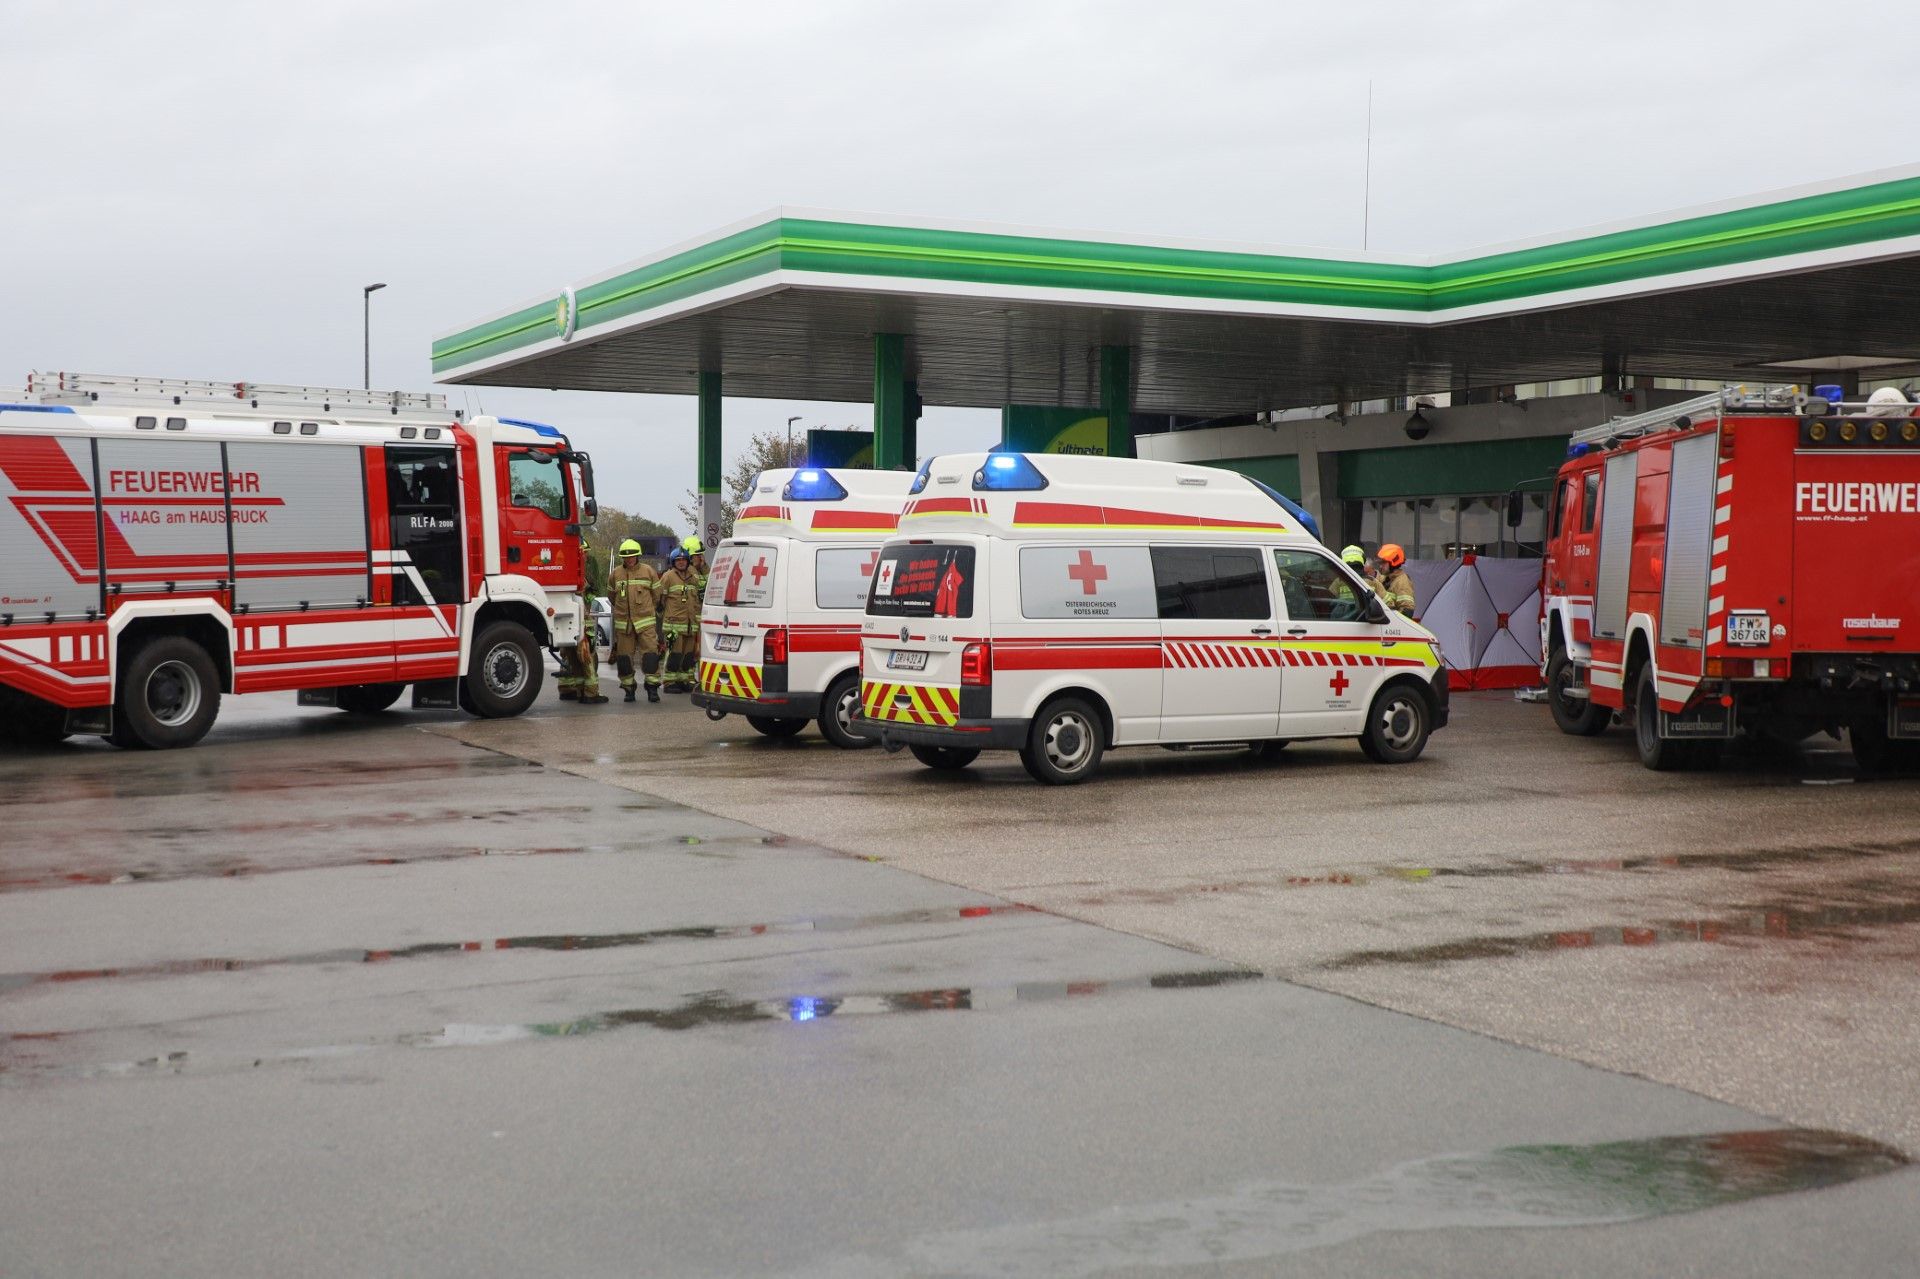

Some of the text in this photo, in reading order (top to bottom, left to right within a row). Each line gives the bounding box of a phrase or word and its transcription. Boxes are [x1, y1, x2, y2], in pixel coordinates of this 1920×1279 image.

[110, 470, 260, 493] FEUERWEHR
[1796, 482, 1920, 513] FEUERWE
[120, 510, 268, 524] HAAG am HAUSRUCK
[410, 516, 454, 528] RLFA 2000
[1796, 515, 1868, 523] www.ff-haag.at
[1739, 618, 1755, 629] FW
[1843, 612, 1901, 629] rosenbauer
[938, 634, 948, 642] 144
[1731, 629, 1767, 640] 367 GR
